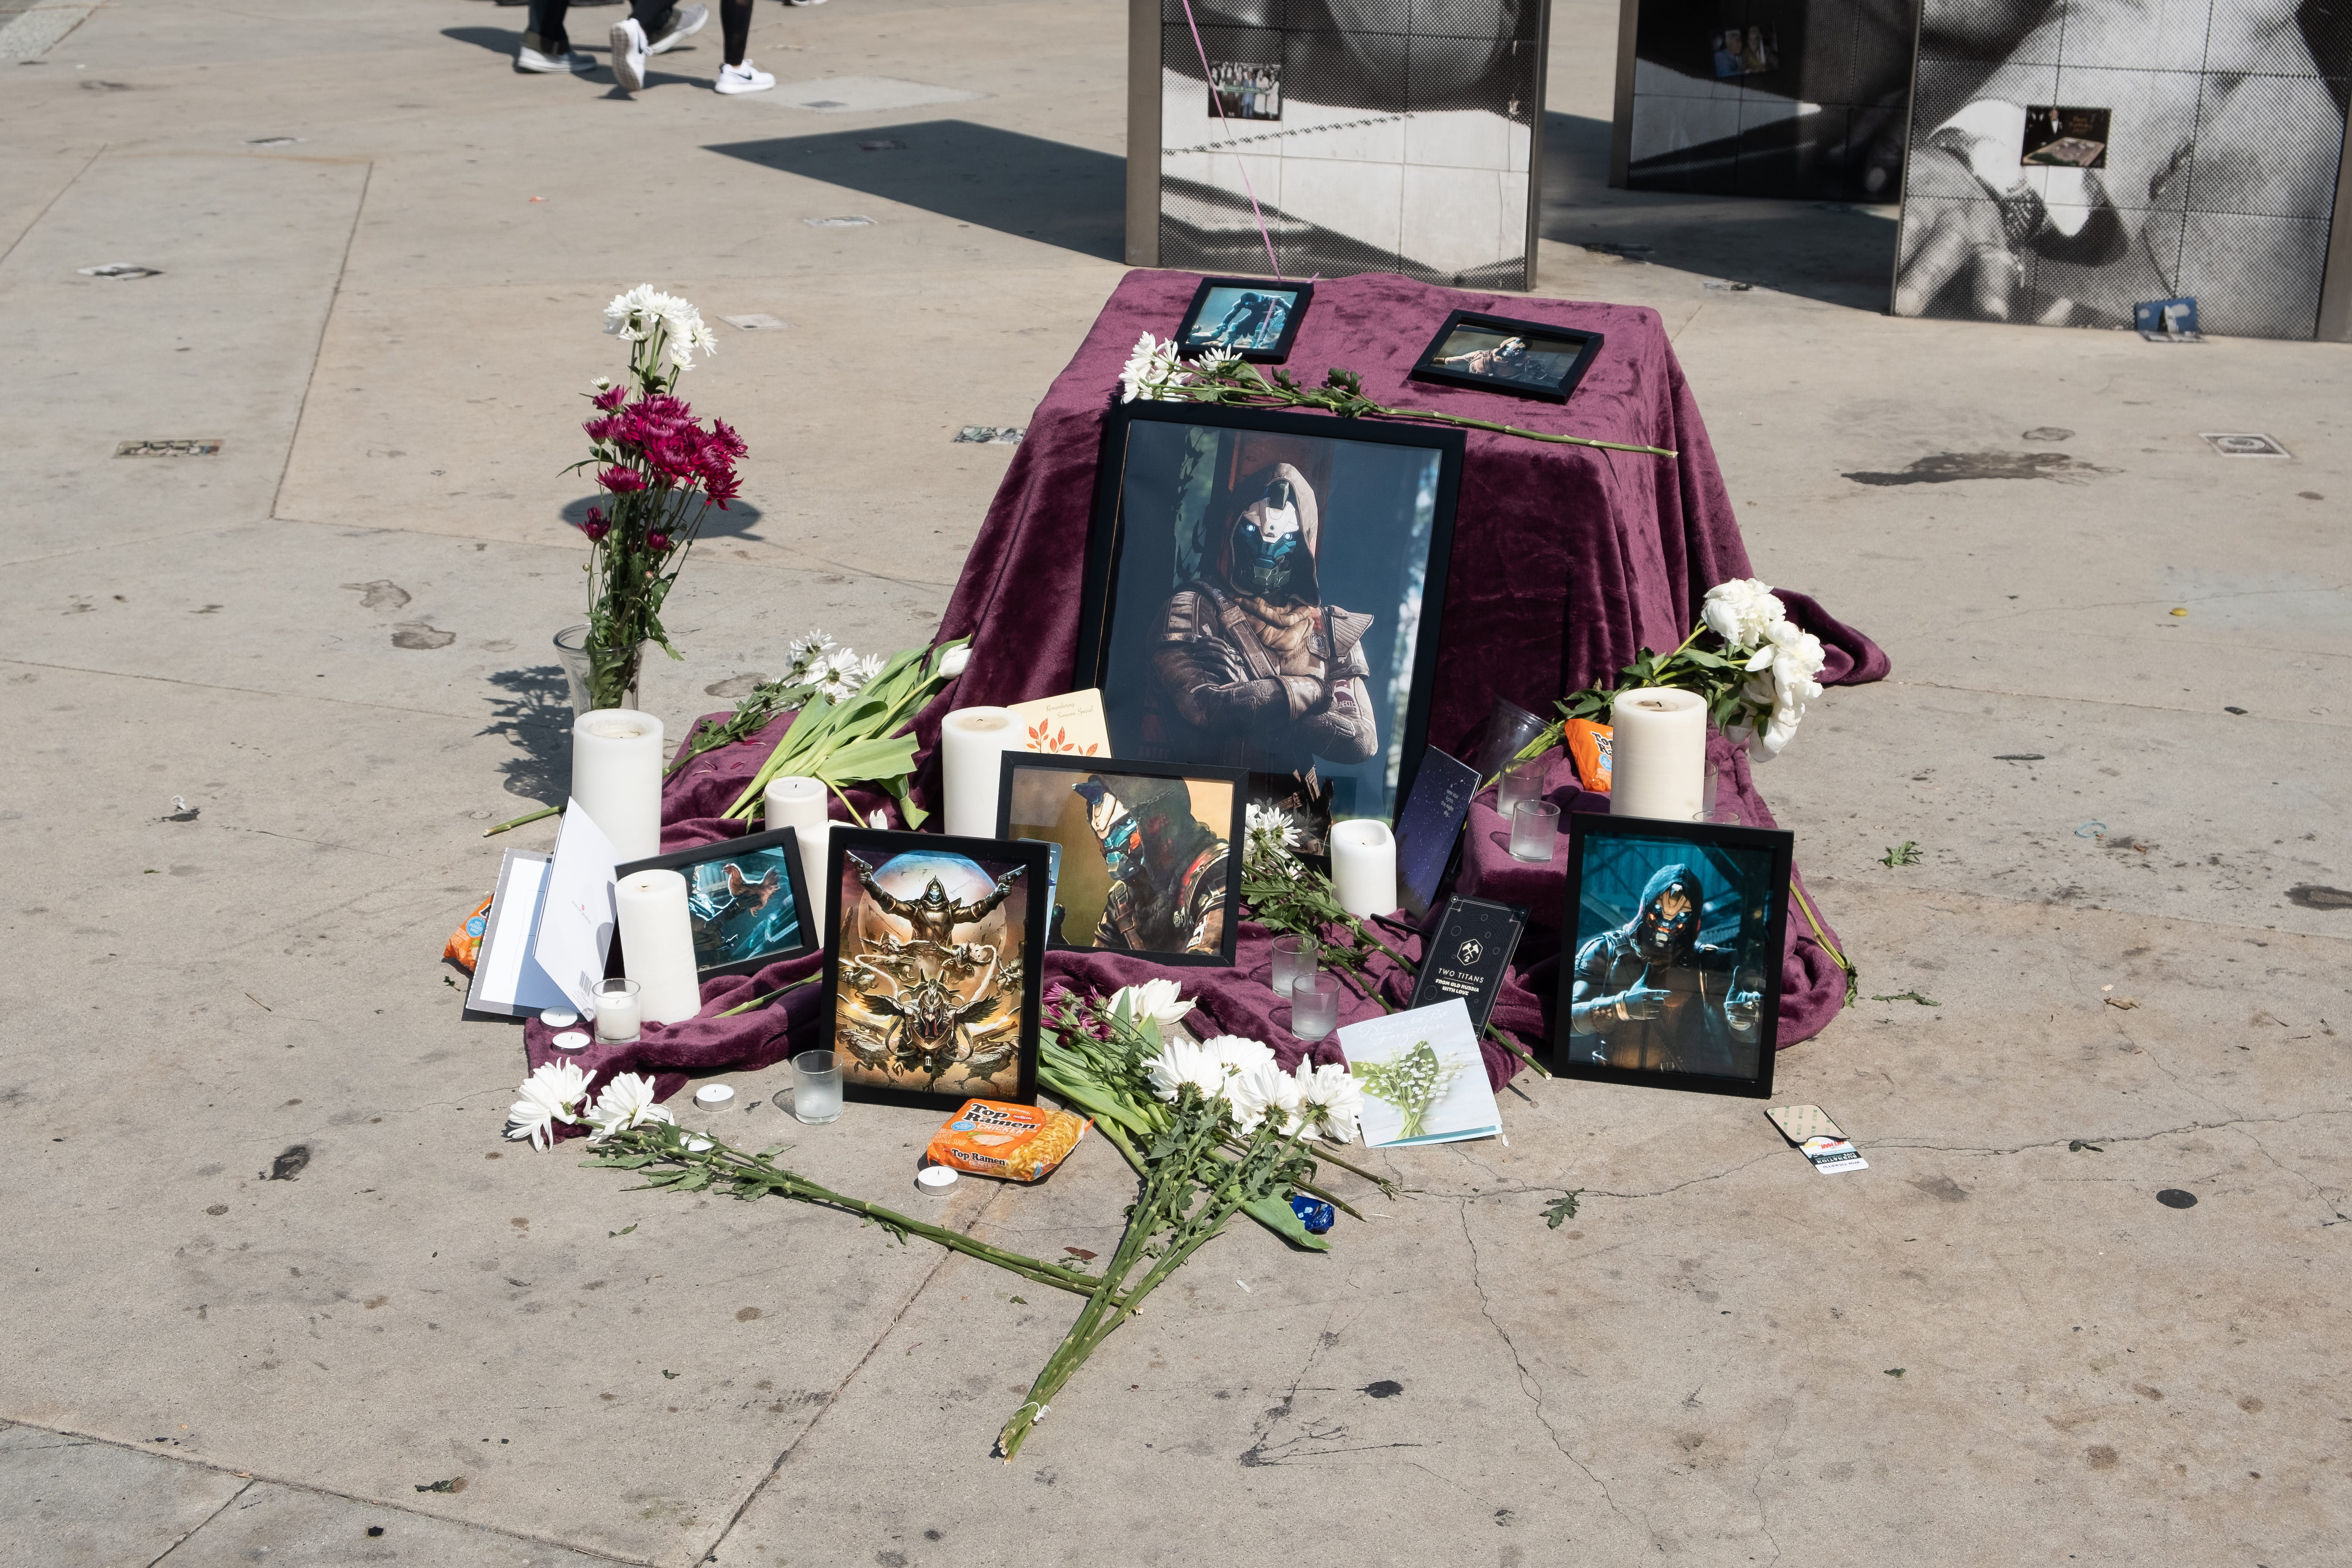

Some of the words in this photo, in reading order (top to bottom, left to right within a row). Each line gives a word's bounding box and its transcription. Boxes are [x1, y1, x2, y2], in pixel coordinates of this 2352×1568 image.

[1046, 702, 1074, 711] Remembering
[1078, 705, 1093, 716] Special
[1446, 804, 1454, 812] night
[1438, 968, 1455, 977] TWO
[1458, 972, 1484, 983] TITANS
[1461, 984, 1479, 992] RUSSIA
[1359, 1020, 1407, 1038] Never
[1411, 1015, 1424, 1024] to
[1424, 1008, 1452, 1022] Be
[1369, 1023, 1451, 1046] Forgotten
[971, 1104, 1008, 1120] Top
[963, 1112, 1037, 1129] Ramen
[977, 1123, 1026, 1134] CHICKEN
[953, 1139, 968, 1147] SOUP
[951, 1149, 970, 1161] Top
[972, 1153, 1005, 1166] Ramen
[969, 1160, 992, 1168] CHICKEN
